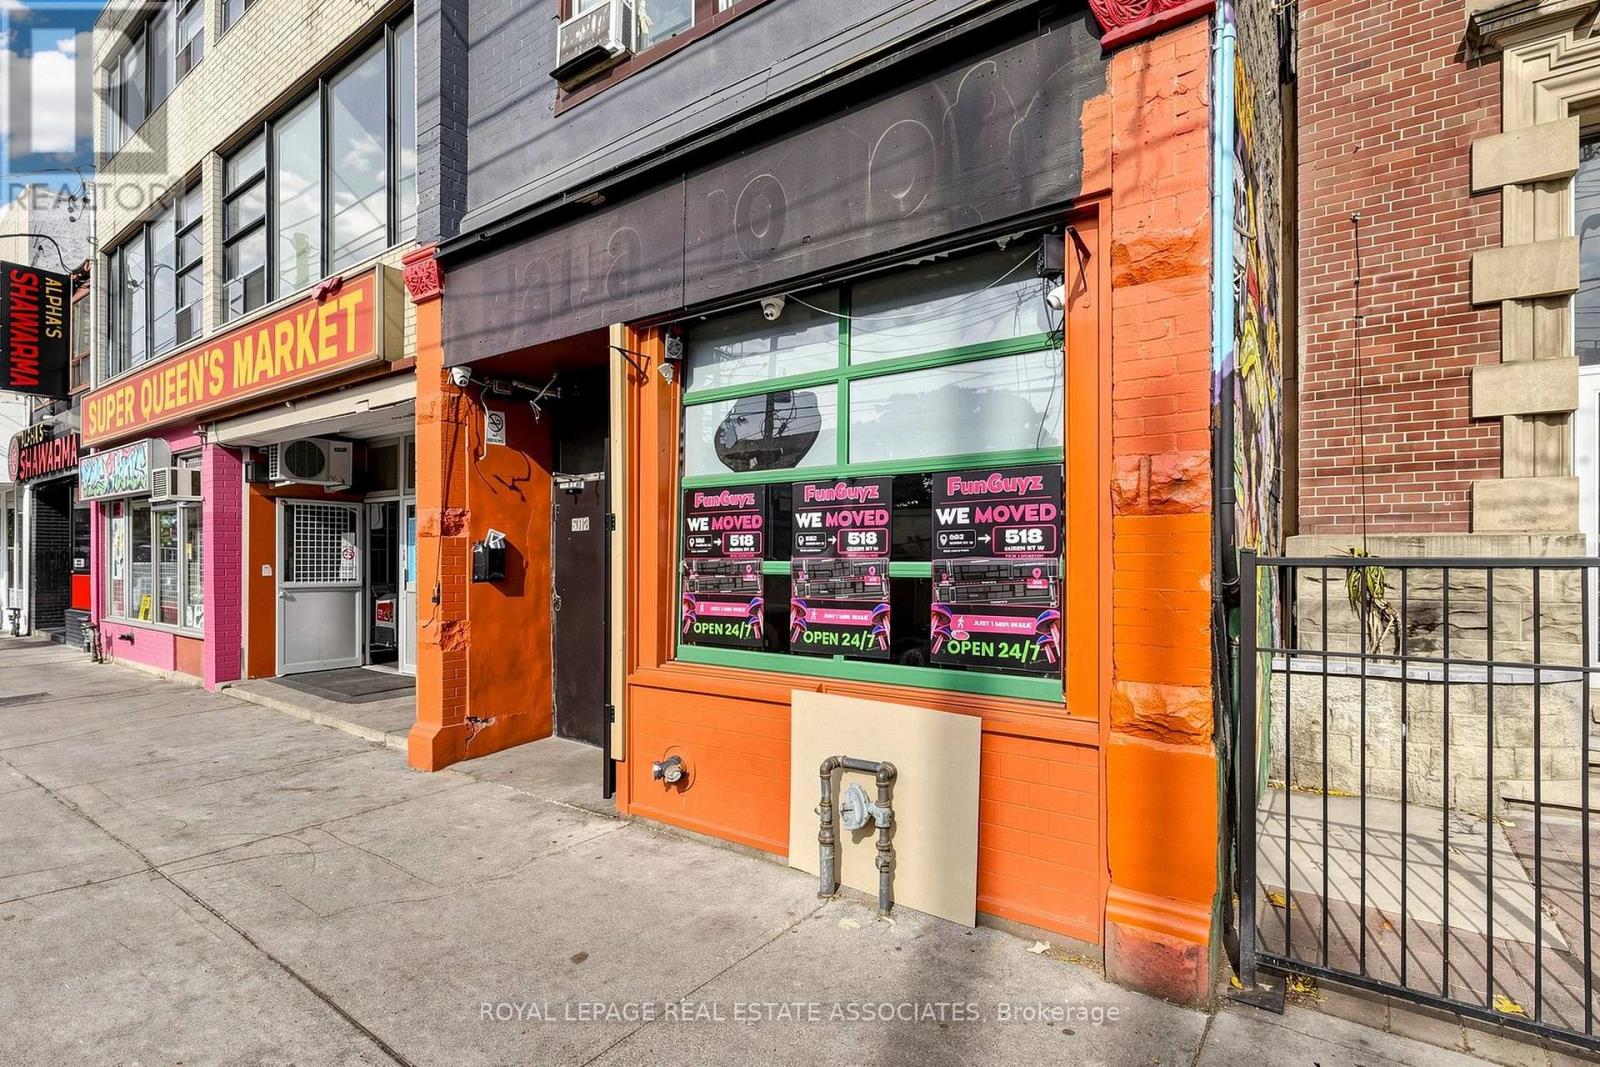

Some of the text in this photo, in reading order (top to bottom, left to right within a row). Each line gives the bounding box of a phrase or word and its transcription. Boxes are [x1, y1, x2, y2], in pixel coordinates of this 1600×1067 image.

[45, 277, 62, 338] ALPHA'S
[9, 268, 39, 386] SHAWARMA
[87, 289, 364, 436] SUPER QUEEN'S MARKET
[20, 434, 78, 480] SHAWARMA
[804, 482, 879, 503] FunGuyz
[946, 472, 1044, 496] FunGuyz
[694, 490, 755, 508] FunGuyz
[687, 515, 763, 532] WE MOVED
[795, 509, 889, 528] WE MOVED
[935, 503, 1057, 525] WE MOVED
[729, 534, 754, 547] 518
[847, 531, 878, 545] 518
[1005, 528, 1043, 544] 518
[693, 621, 752, 639] OPEN 24/7
[803, 630, 876, 650] OPEN 24/7
[947, 640, 1041, 663] OPEN 24/7
